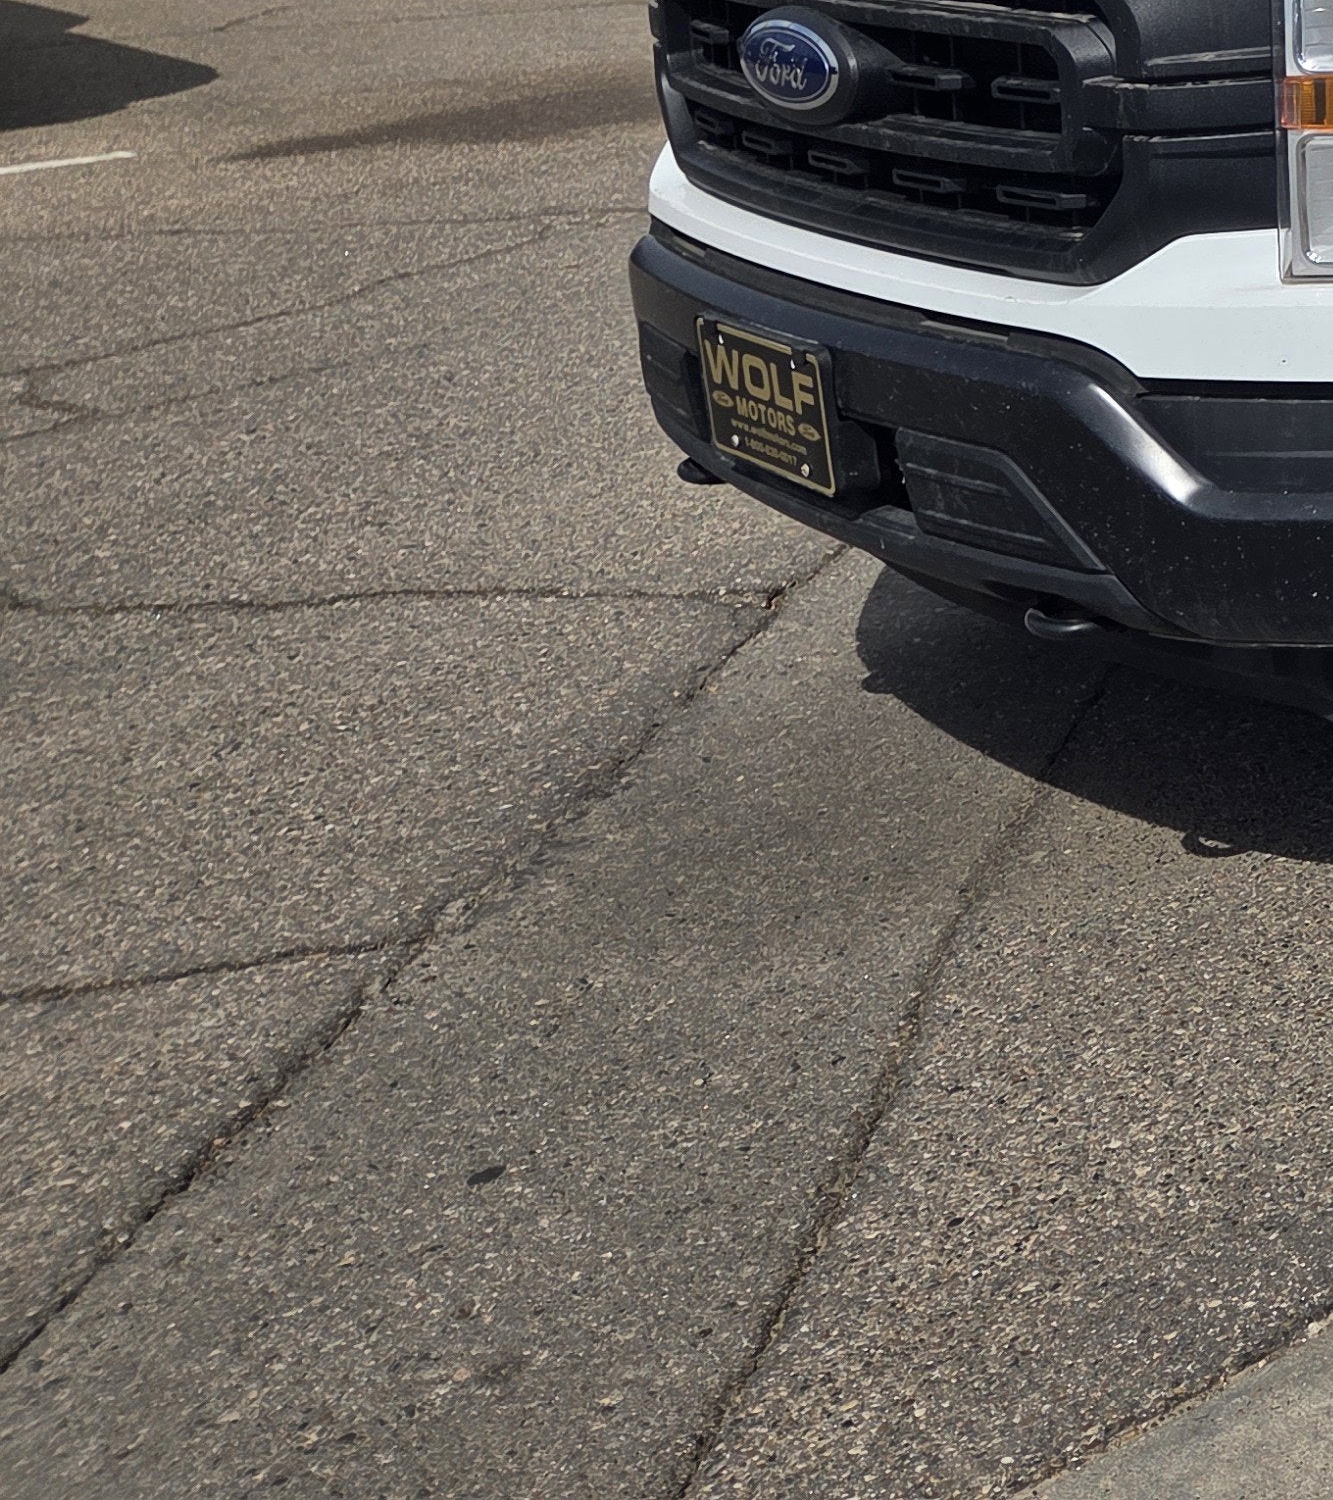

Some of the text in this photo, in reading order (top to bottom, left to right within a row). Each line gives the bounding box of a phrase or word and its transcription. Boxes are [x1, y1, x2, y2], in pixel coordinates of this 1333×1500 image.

[755, 37, 809, 91] Ford
[704, 339, 815, 415] WOLF
[735, 395, 796, 437] MOTORS
